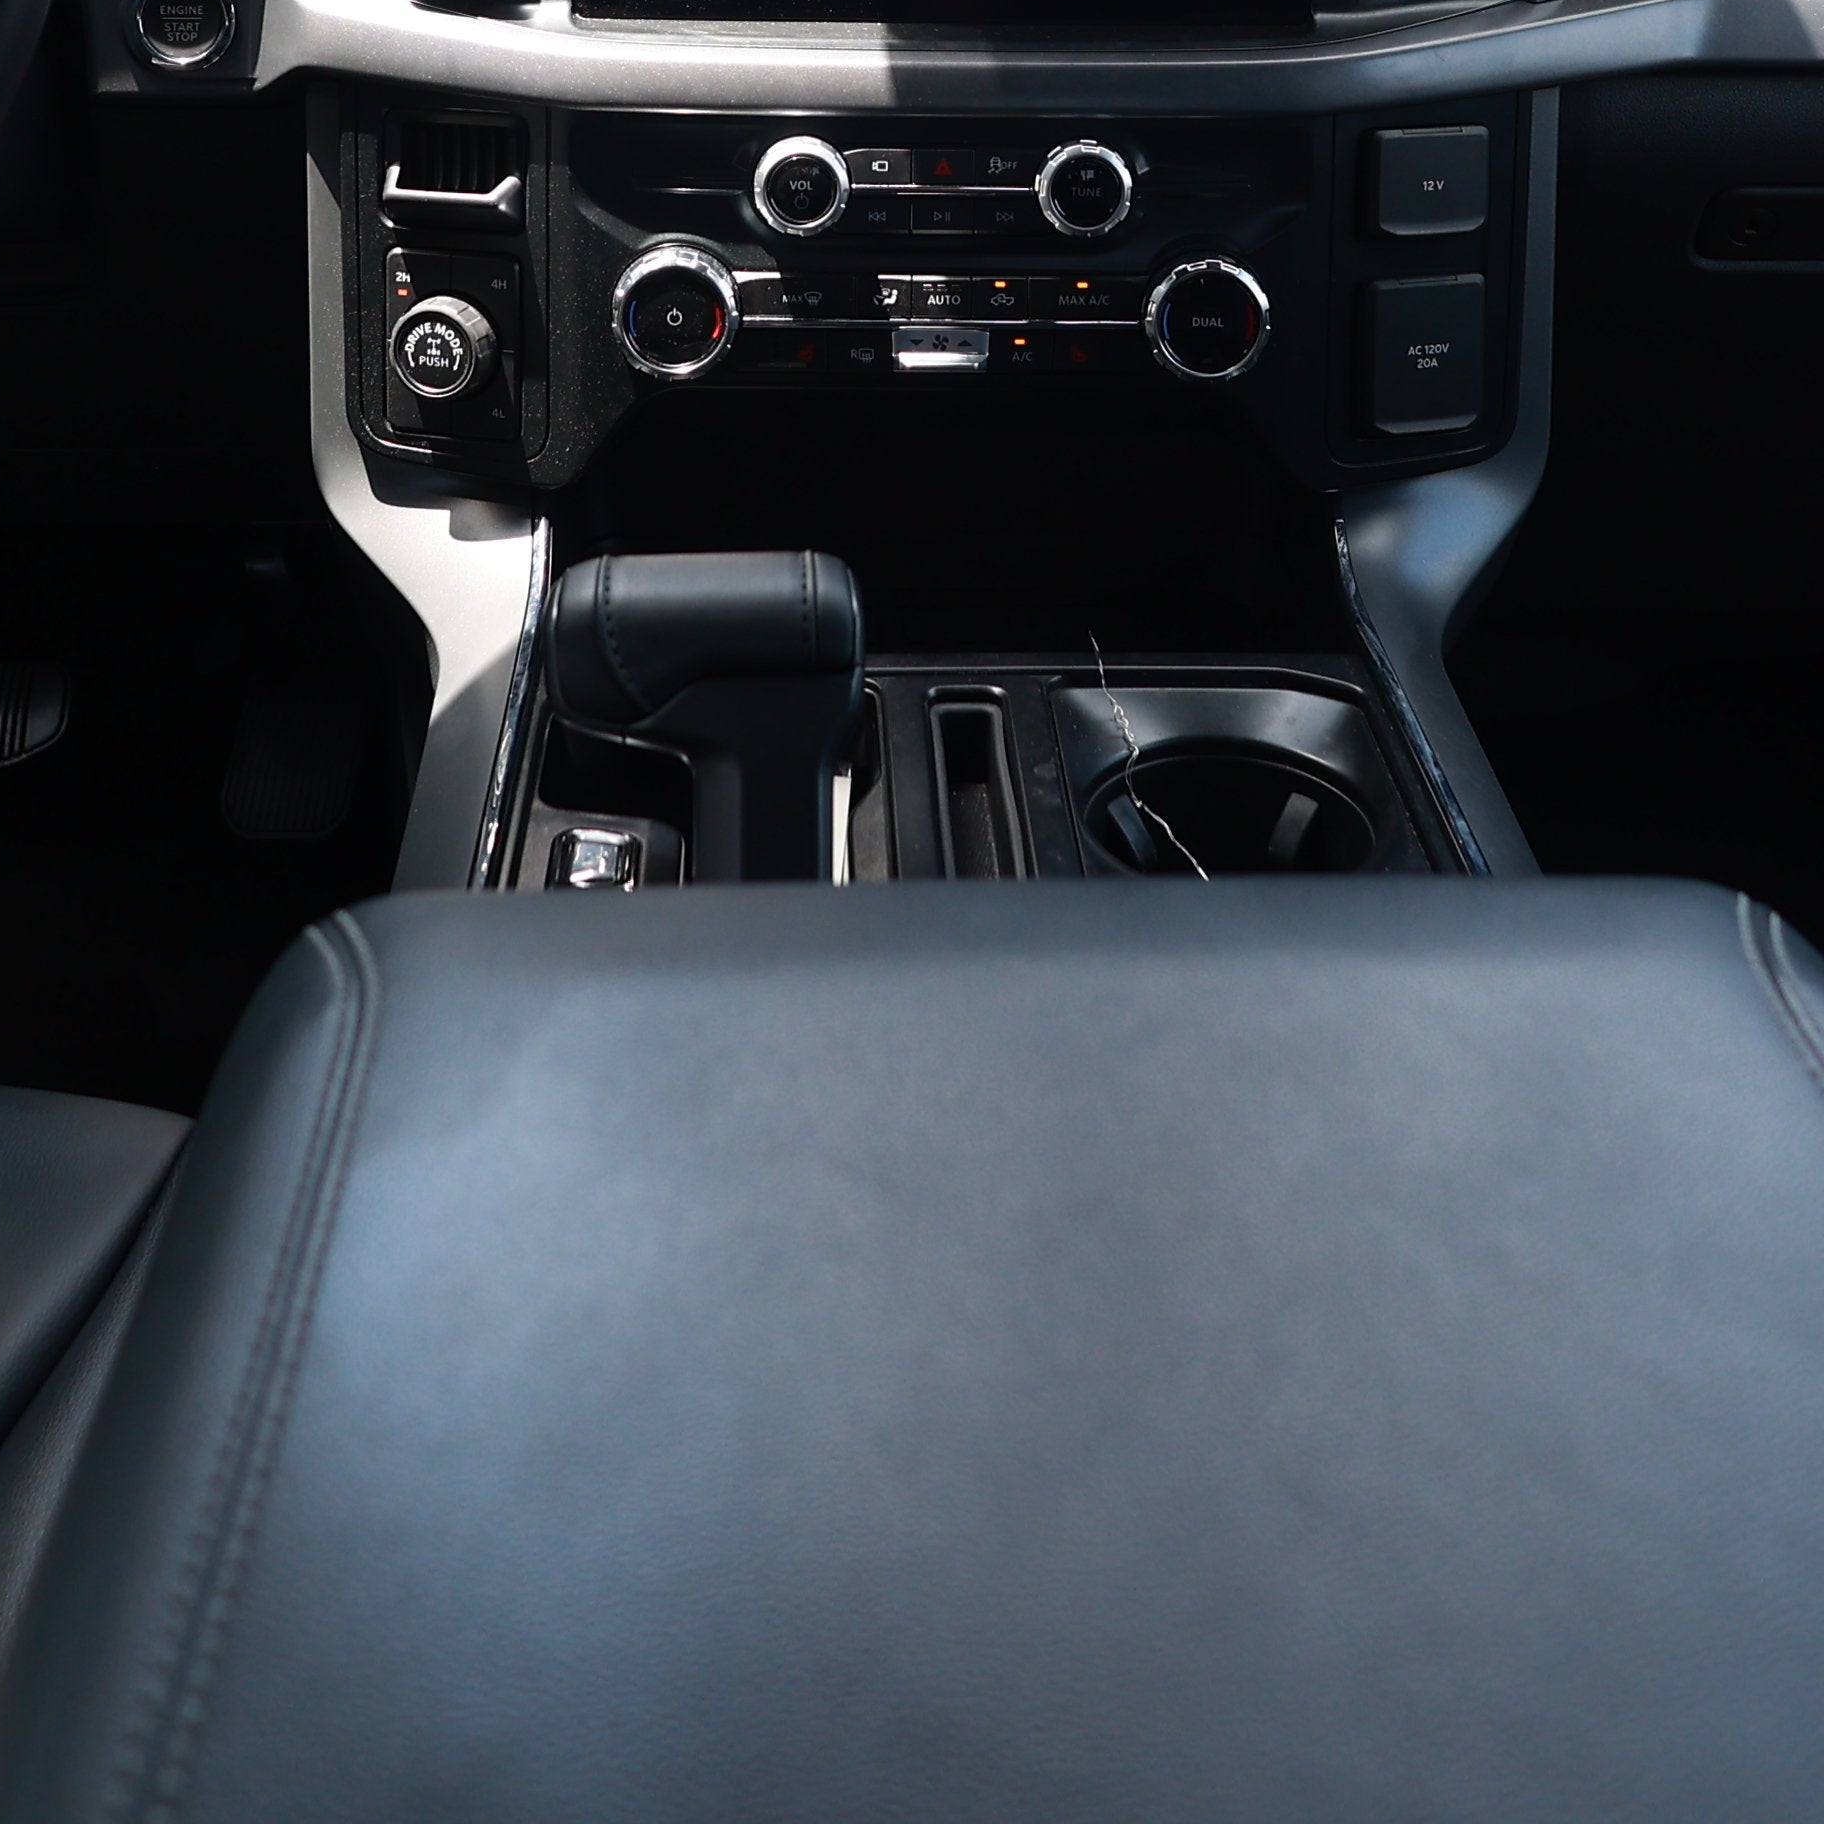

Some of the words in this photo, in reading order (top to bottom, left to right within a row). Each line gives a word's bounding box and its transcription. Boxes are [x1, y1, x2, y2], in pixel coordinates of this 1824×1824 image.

[159, 5, 204, 15] ENGINE
[164, 22, 200, 32] START
[167, 32, 197, 42] STOP
[1000, 161, 1018, 171] OFF
[789, 180, 813, 192] VOL
[1071, 187, 1102, 198] TUNE
[395, 271, 411, 283] 2H
[491, 279, 507, 290] 4H
[782, 294, 803, 304] MAX
[927, 294, 961, 306] AUTO
[1059, 295, 1085, 306] MAX
[1087, 294, 1110, 306] A/C
[1191, 317, 1224, 328] DUAL
[405, 322, 431, 352] DRIVE
[434, 322, 463, 356] MODE
[1408, 344, 1422, 356] AC
[1423, 343, 1450, 355] 120V
[419, 356, 449, 368] PUSH
[1012, 351, 1033, 362] A/C
[1416, 358, 1438, 369] 20A
[491, 408, 505, 419] 4L
